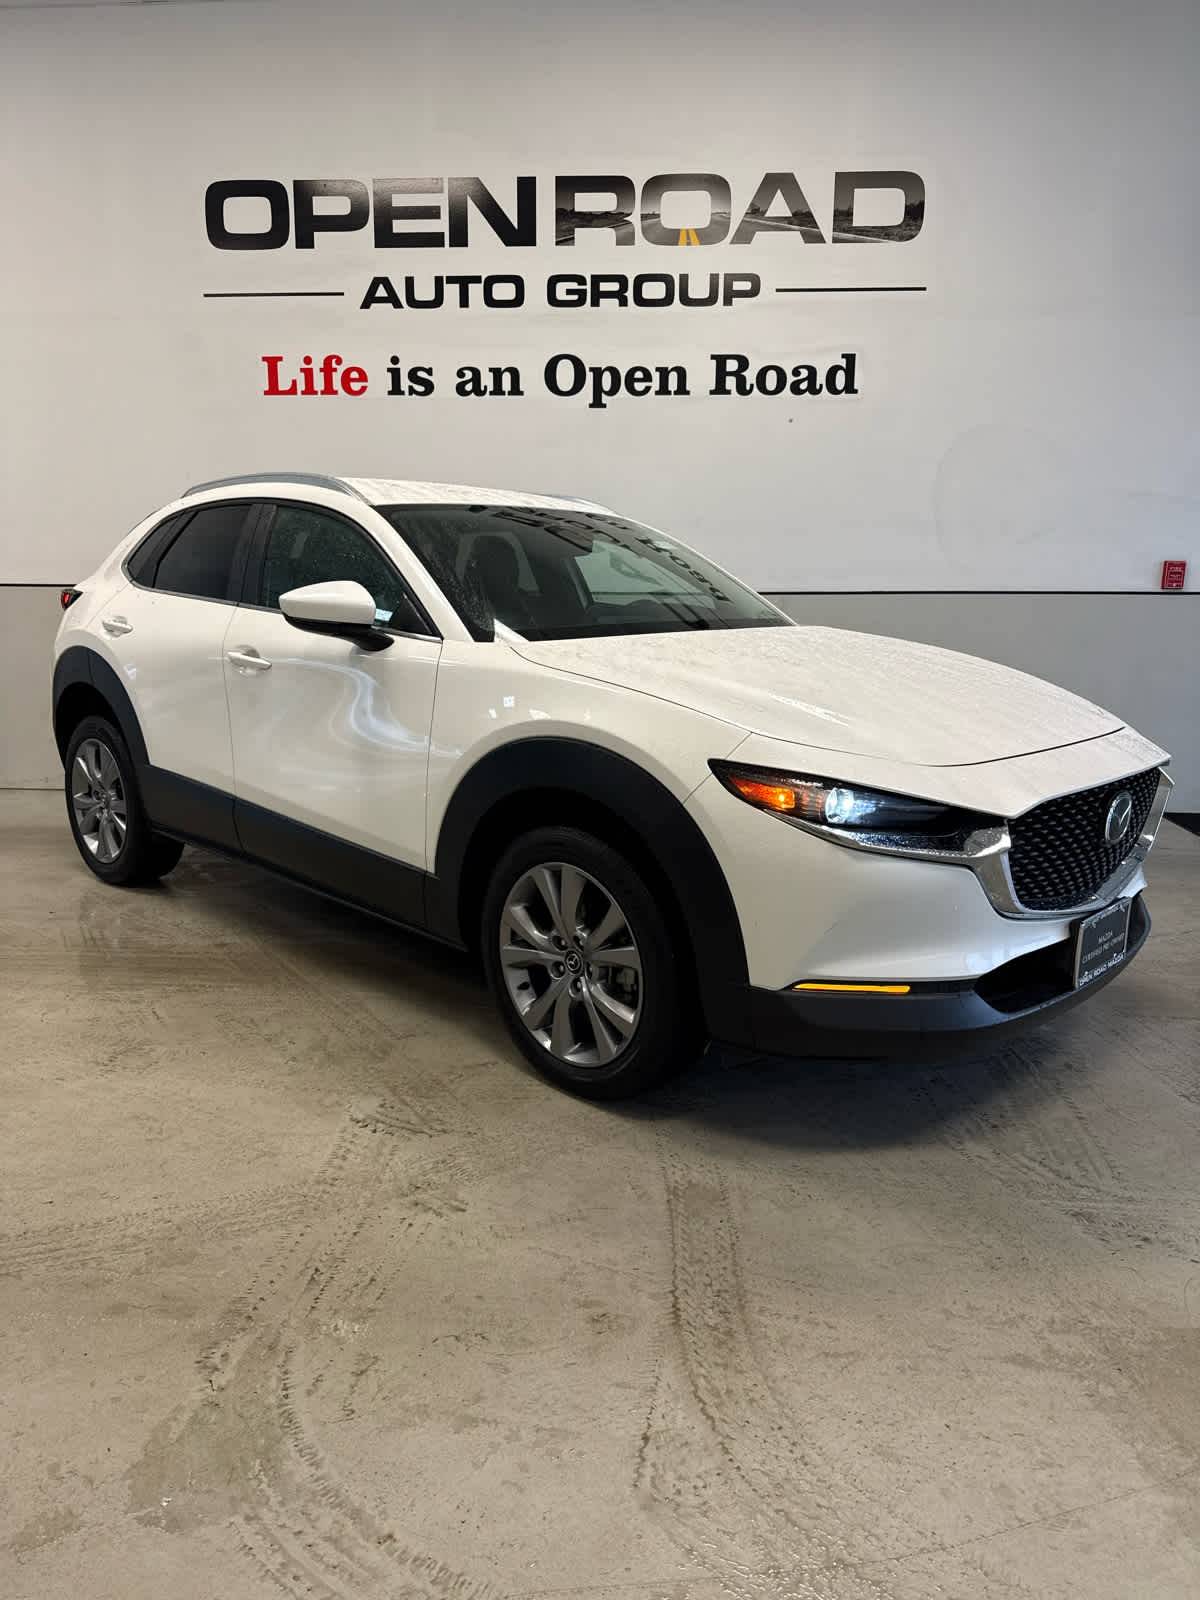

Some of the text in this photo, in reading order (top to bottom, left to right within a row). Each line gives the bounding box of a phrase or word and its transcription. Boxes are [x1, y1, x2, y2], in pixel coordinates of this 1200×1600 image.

[205, 171, 926, 250] OPEN ROAD
[360, 273, 762, 309] AUTO GROUP
[262, 353, 859, 409] Life is an Open Road
[1093, 964, 1107, 977] ROAD
